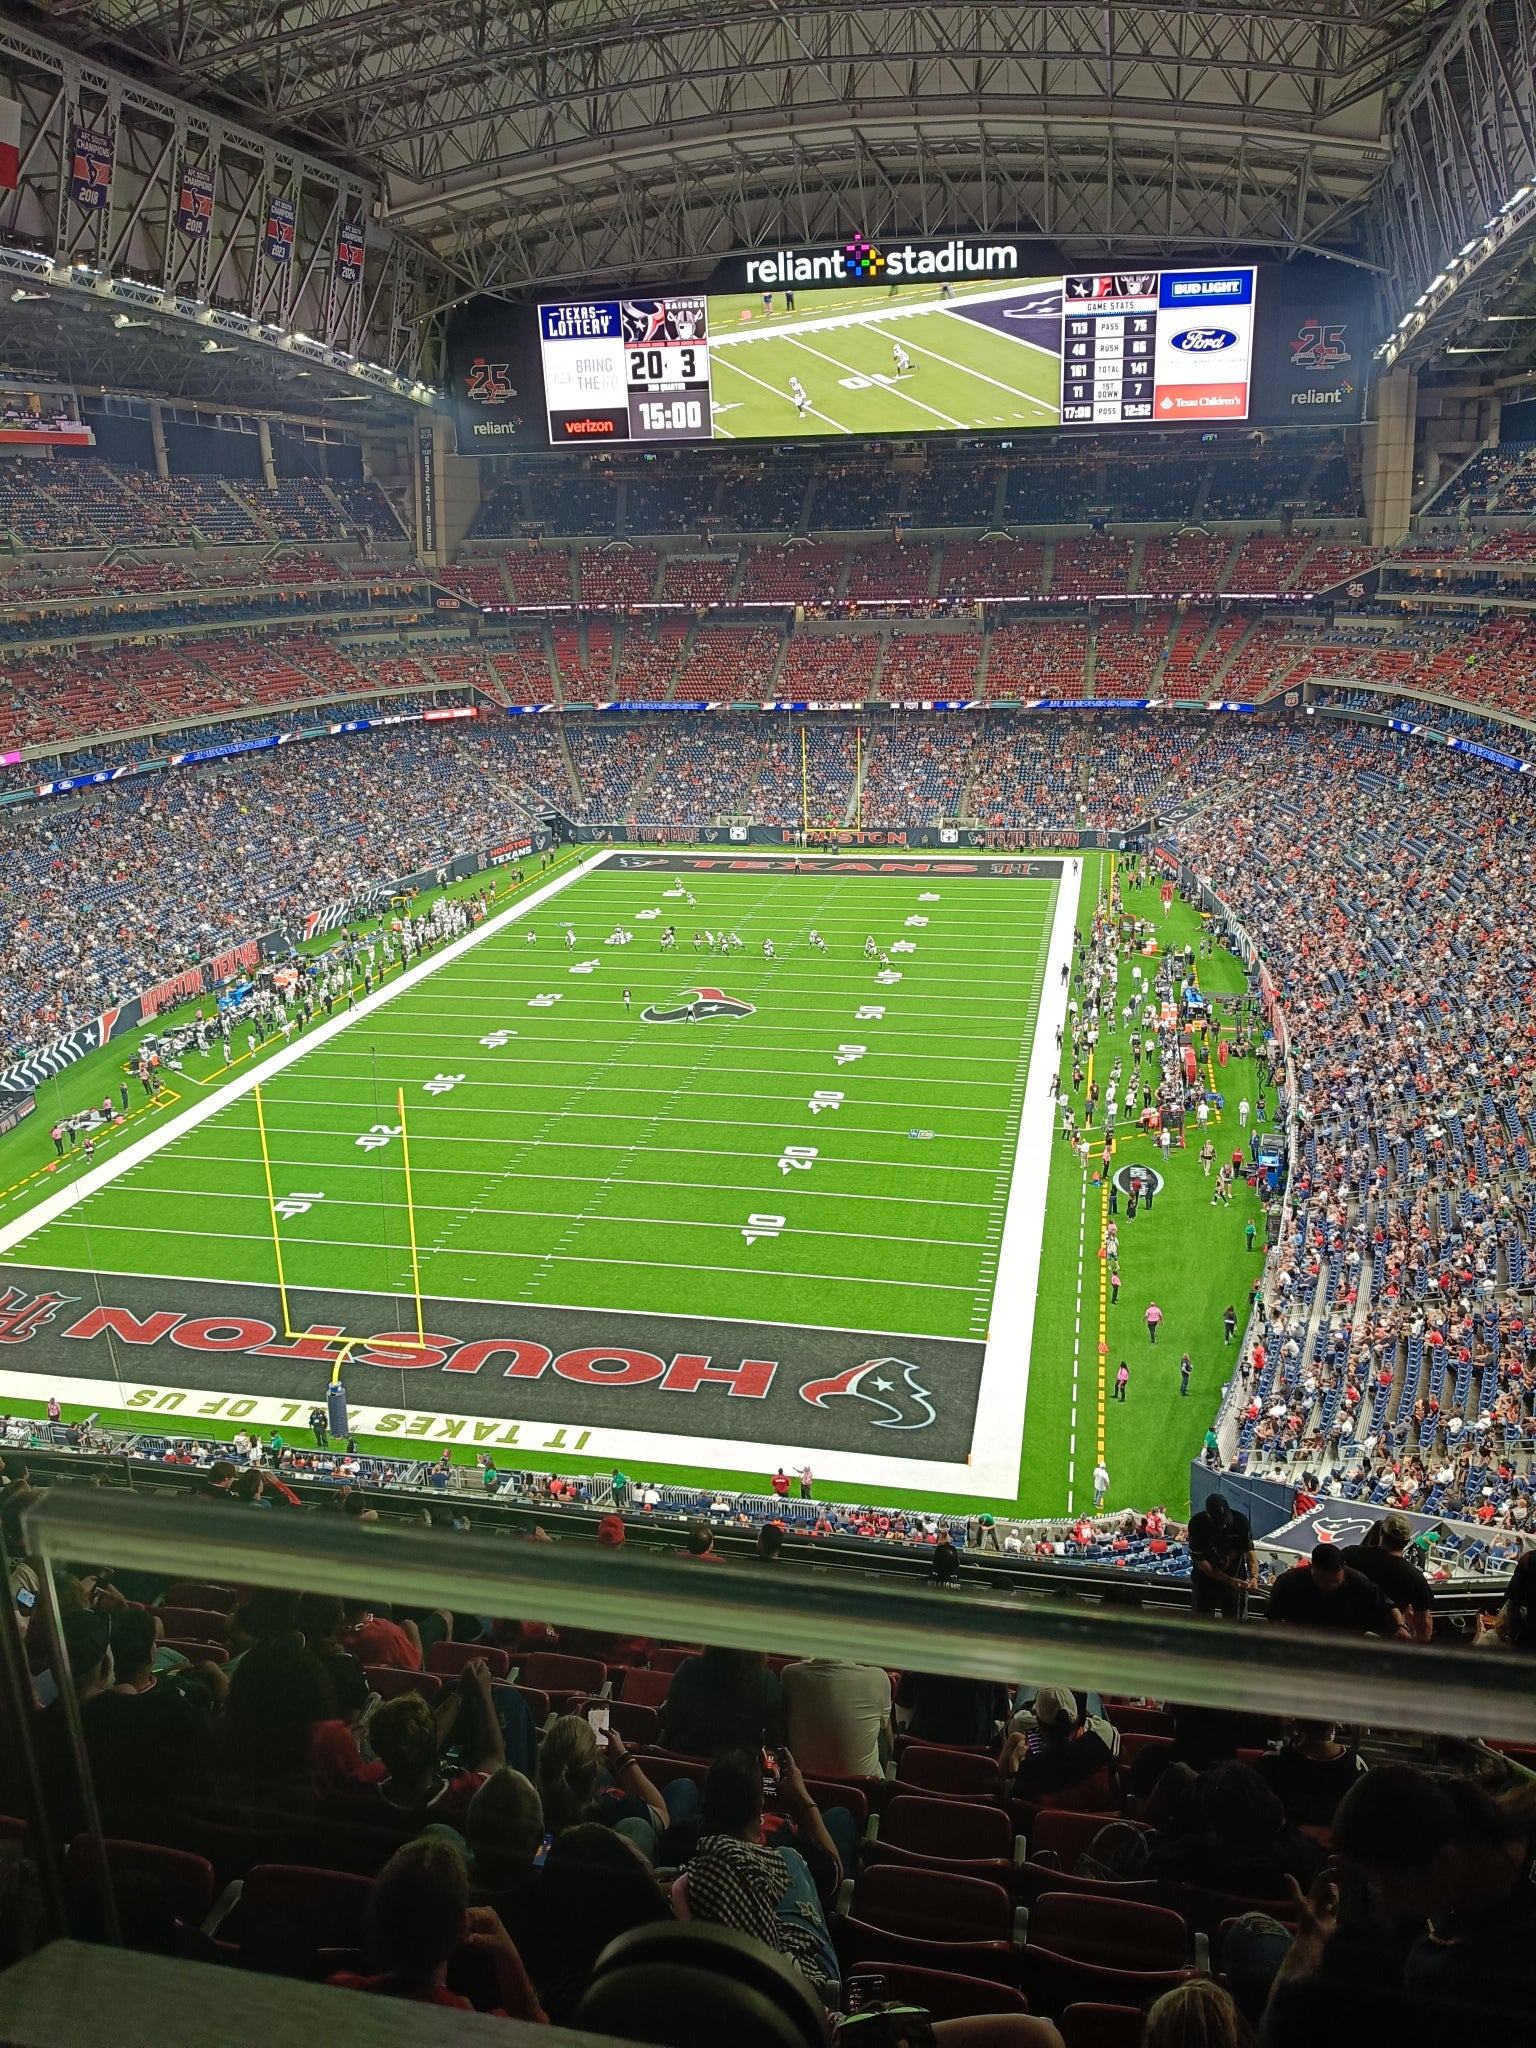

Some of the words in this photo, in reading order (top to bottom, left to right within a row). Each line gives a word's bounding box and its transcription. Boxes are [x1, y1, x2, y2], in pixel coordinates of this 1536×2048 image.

[80, 131, 91, 142] AFC
[92, 135, 108, 147] SOUTH
[76, 138, 110, 158] CHAMPIONS
[188, 168, 196, 178] AFC
[196, 172, 211, 182] SOUTH
[184, 176, 213, 192] CHAMPIONS
[79, 188, 98, 204] 2018
[271, 204, 294, 220] CHAMPIONS
[186, 218, 203, 234] 2019
[342, 230, 363, 244] CHAMPIONS
[272, 244, 286, 258] 2023
[746, 250, 847, 283] reliant
[886, 241, 1018, 275] stadium
[341, 266, 356, 280] 2024
[1174, 282, 1200, 295] BUD
[1202, 281, 1240, 294] LIGHT
[558, 306, 596, 320] TEXAS
[665, 302, 704, 310] RAIDERS
[1087, 302, 1108, 311] GAME
[1110, 302, 1134, 310] STATS
[549, 315, 610, 336] LOTTERY
[1101, 322, 1119, 331] PASS
[1100, 344, 1118, 352] RUSH
[1182, 330, 1224, 350] Ford
[1298, 325, 1348, 366] 25
[576, 358, 613, 374] BRING
[630, 350, 662, 380] 20
[680, 349, 696, 378] 3
[1098, 366, 1119, 374] TOTAL
[1130, 362, 1148, 374] 141
[470, 364, 512, 400] 25
[576, 376, 601, 390] THE
[1073, 386, 1084, 398] 11
[1102, 383, 1114, 391] 1ST
[1134, 384, 1142, 396] 7
[1098, 390, 1118, 398] DOWN
[1291, 388, 1342, 404] reliant
[1176, 398, 1198, 408] Texas
[1199, 396, 1240, 407] Children's
[638, 401, 702, 430] 15:00
[474, 420, 516, 435] reliant
[565, 418, 614, 434] verizon
[670, 827, 700, 842] MADE
[490, 838, 532, 858] HOUSTON
[491, 846, 532, 866] TEXANS
[682, 860, 978, 873] TEXANS
[211, 940, 260, 982] TEXANS
[478, 1030, 518, 1046] 40
[832, 1044, 867, 1062] 40
[422, 1074, 466, 1092] 30
[808, 1090, 845, 1110] 30
[354, 1124, 402, 1147] 20
[777, 1145, 819, 1170] 20
[274, 1192, 325, 1213] 10
[740, 1213, 786, 1238] 10
[61, 1306, 779, 1399] HOUSTON
[127, 1389, 188, 1410] US
[198, 1397, 258, 1418] OF
[375, 1412, 520, 1445] TAKES
[543, 1428, 592, 1450] IT
